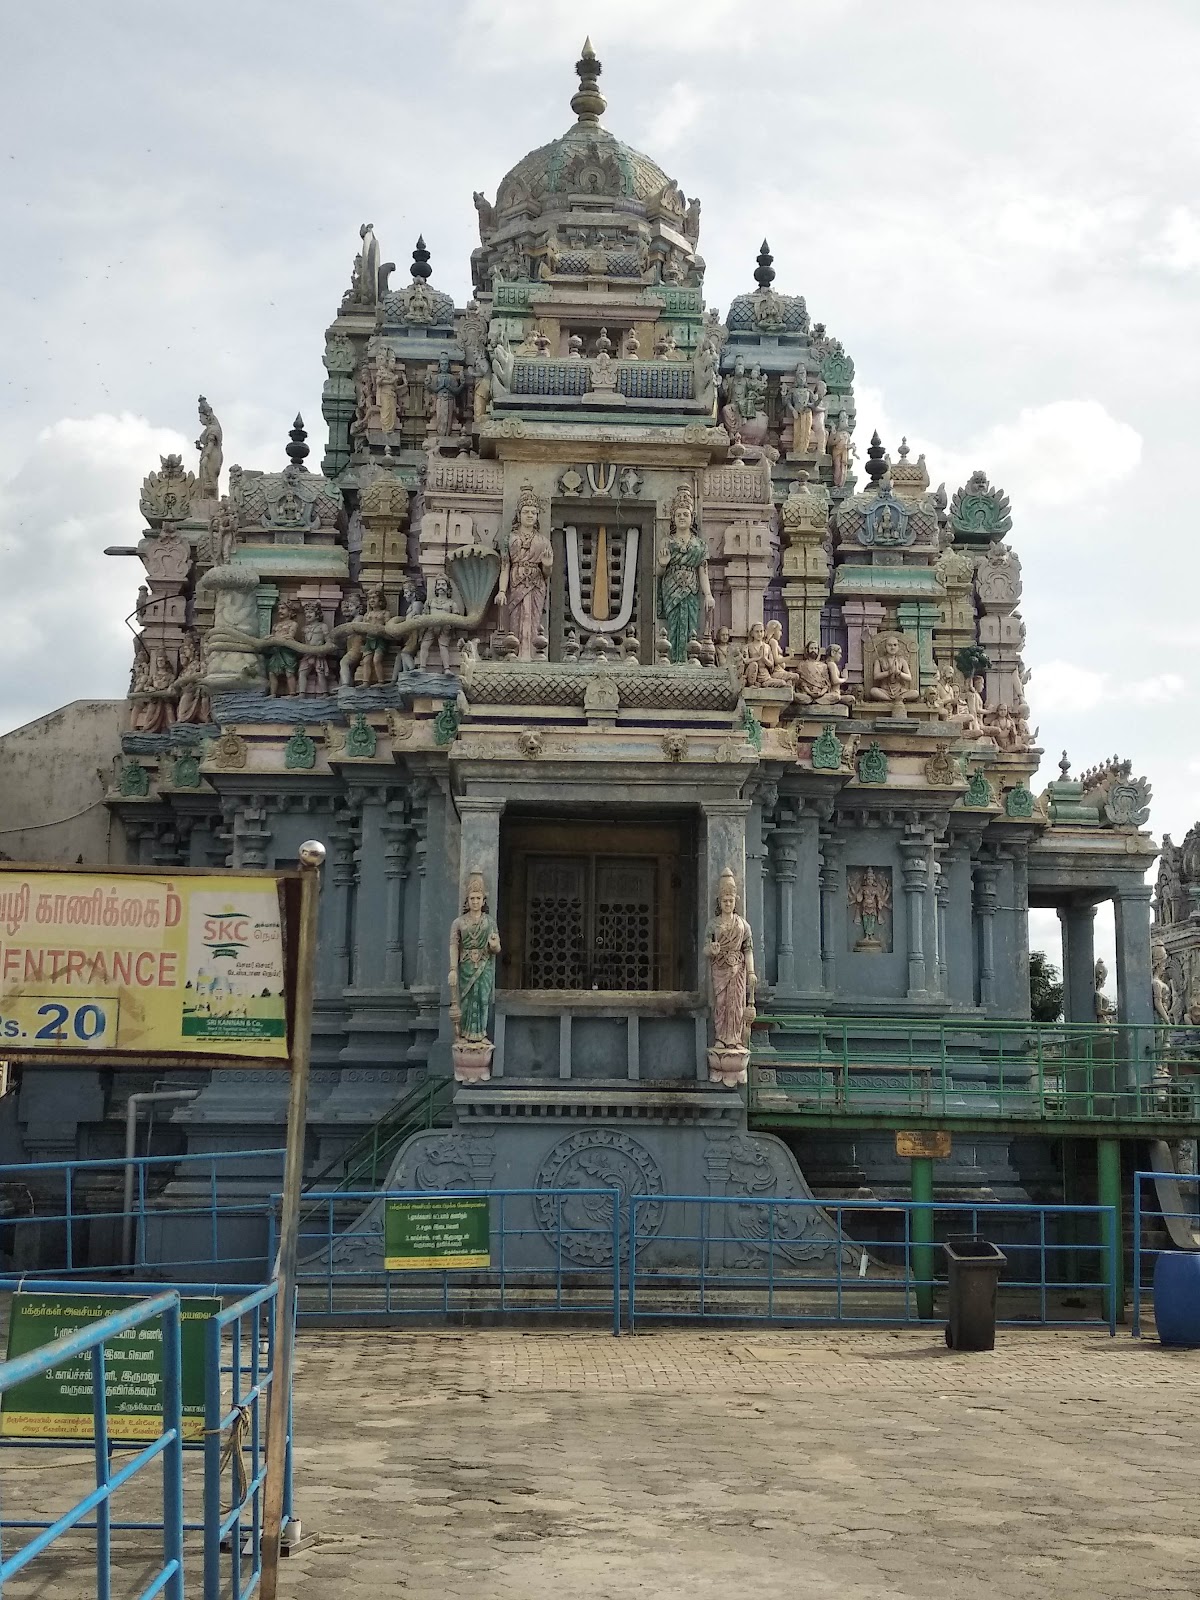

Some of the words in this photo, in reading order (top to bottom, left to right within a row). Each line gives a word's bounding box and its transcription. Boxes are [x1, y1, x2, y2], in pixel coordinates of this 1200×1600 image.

[36, 887, 161, 928] காணிக்கை
[203, 920, 249, 941] SKC
[3, 949, 178, 987] ENTRANCE
[35, 1003, 107, 1041] 20
[21, 1303, 62, 1317] பக்தர்கள்
[63, 1304, 103, 1317] அவசியம்
[104, 1348, 154, 1361] இடைவெளி
[105, 1384, 157, 1397] தவிர்க்கவும்
